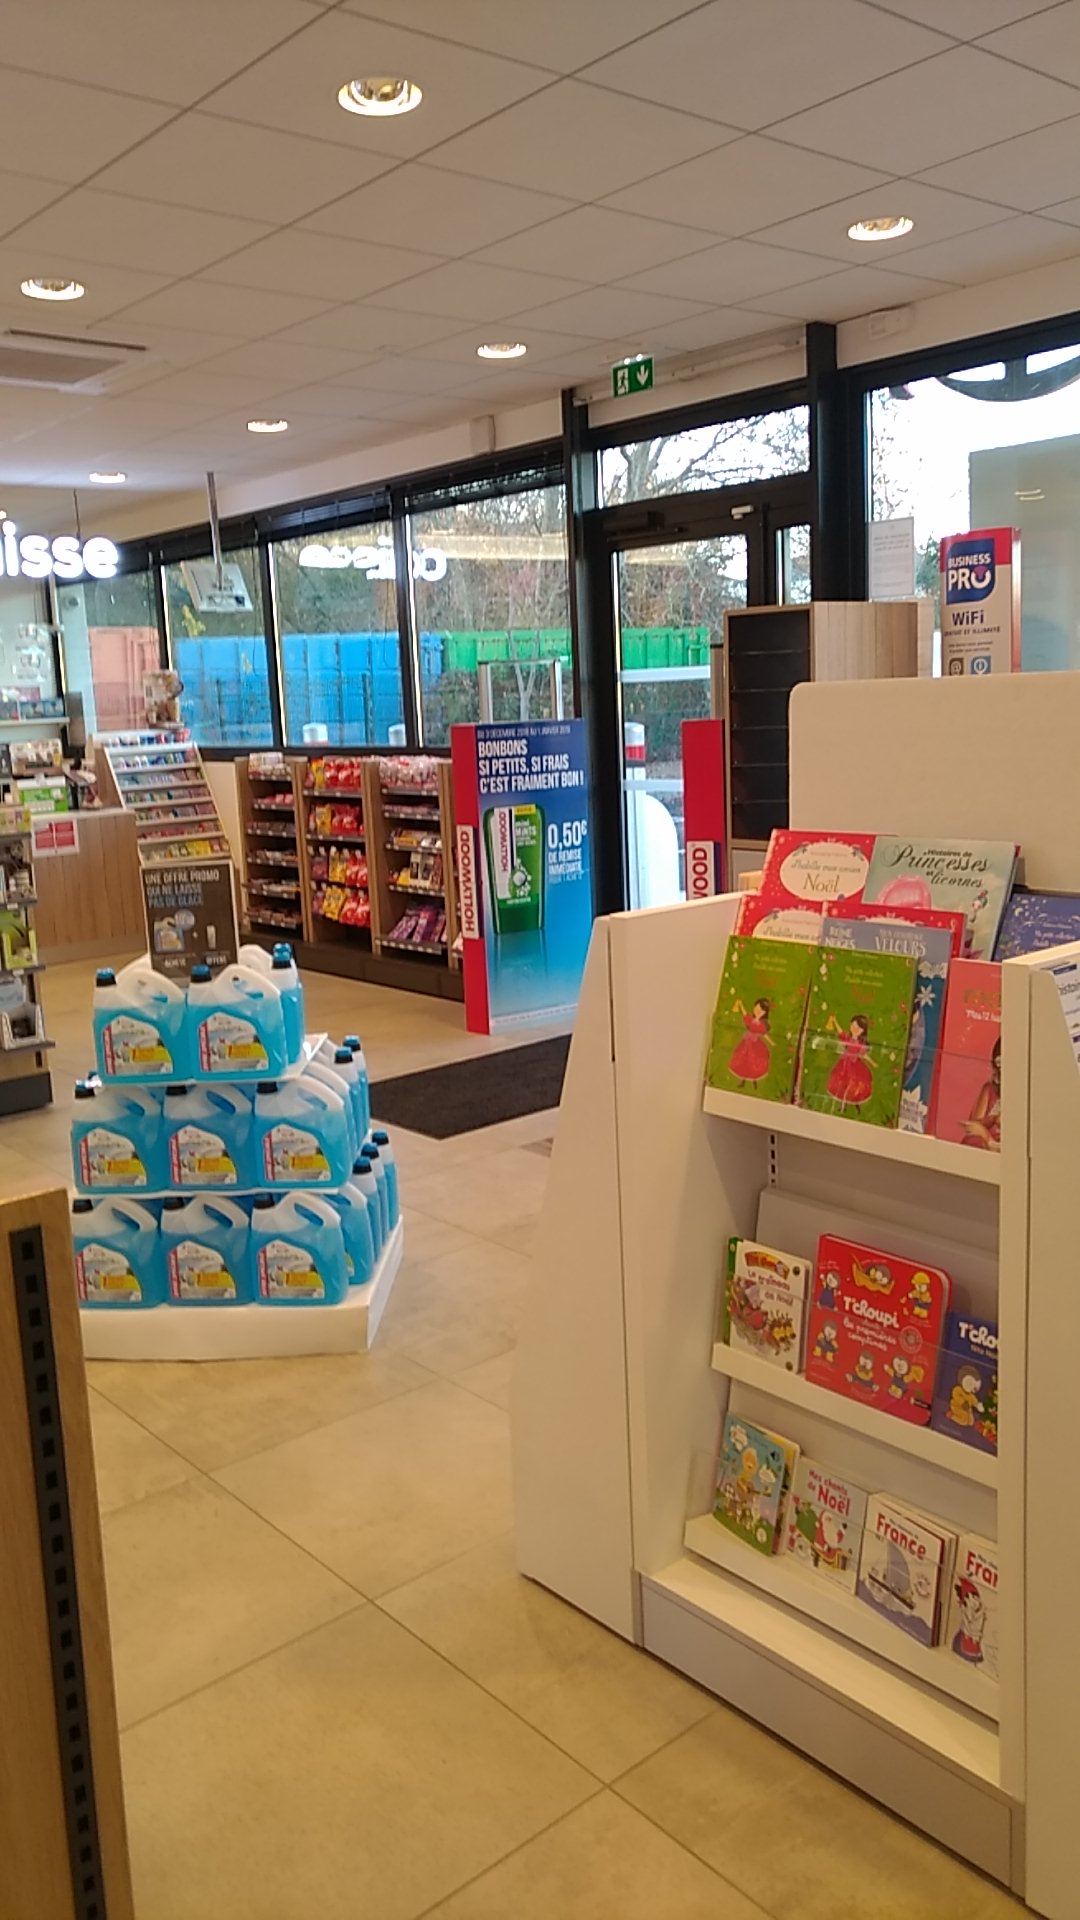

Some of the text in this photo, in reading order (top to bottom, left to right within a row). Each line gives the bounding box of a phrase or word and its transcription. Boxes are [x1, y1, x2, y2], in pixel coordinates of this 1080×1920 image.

[0, 520, 119, 579] isse
[947, 553, 992, 568] BUSINESS
[948, 568, 992, 591] PRO
[952, 609, 985, 626] WiFi
[478, 739, 528, 758] BONBONS
[479, 753, 570, 776] SI PETITS, SI FRAIS
[480, 775, 510, 794] C'EST
[511, 772, 560, 792] FRAIMENT
[498, 811, 509, 872] HOLLYWOOD
[558, 848, 582, 862] REMISE
[459, 831, 475, 932] HOLLYWOOD
[803, 873, 840, 893] Noël
[930, 868, 982, 888] licornes
[843, 1295, 900, 1329] T'choupi
[817, 1484, 851, 1517] Noël
[875, 1512, 927, 1560] France
